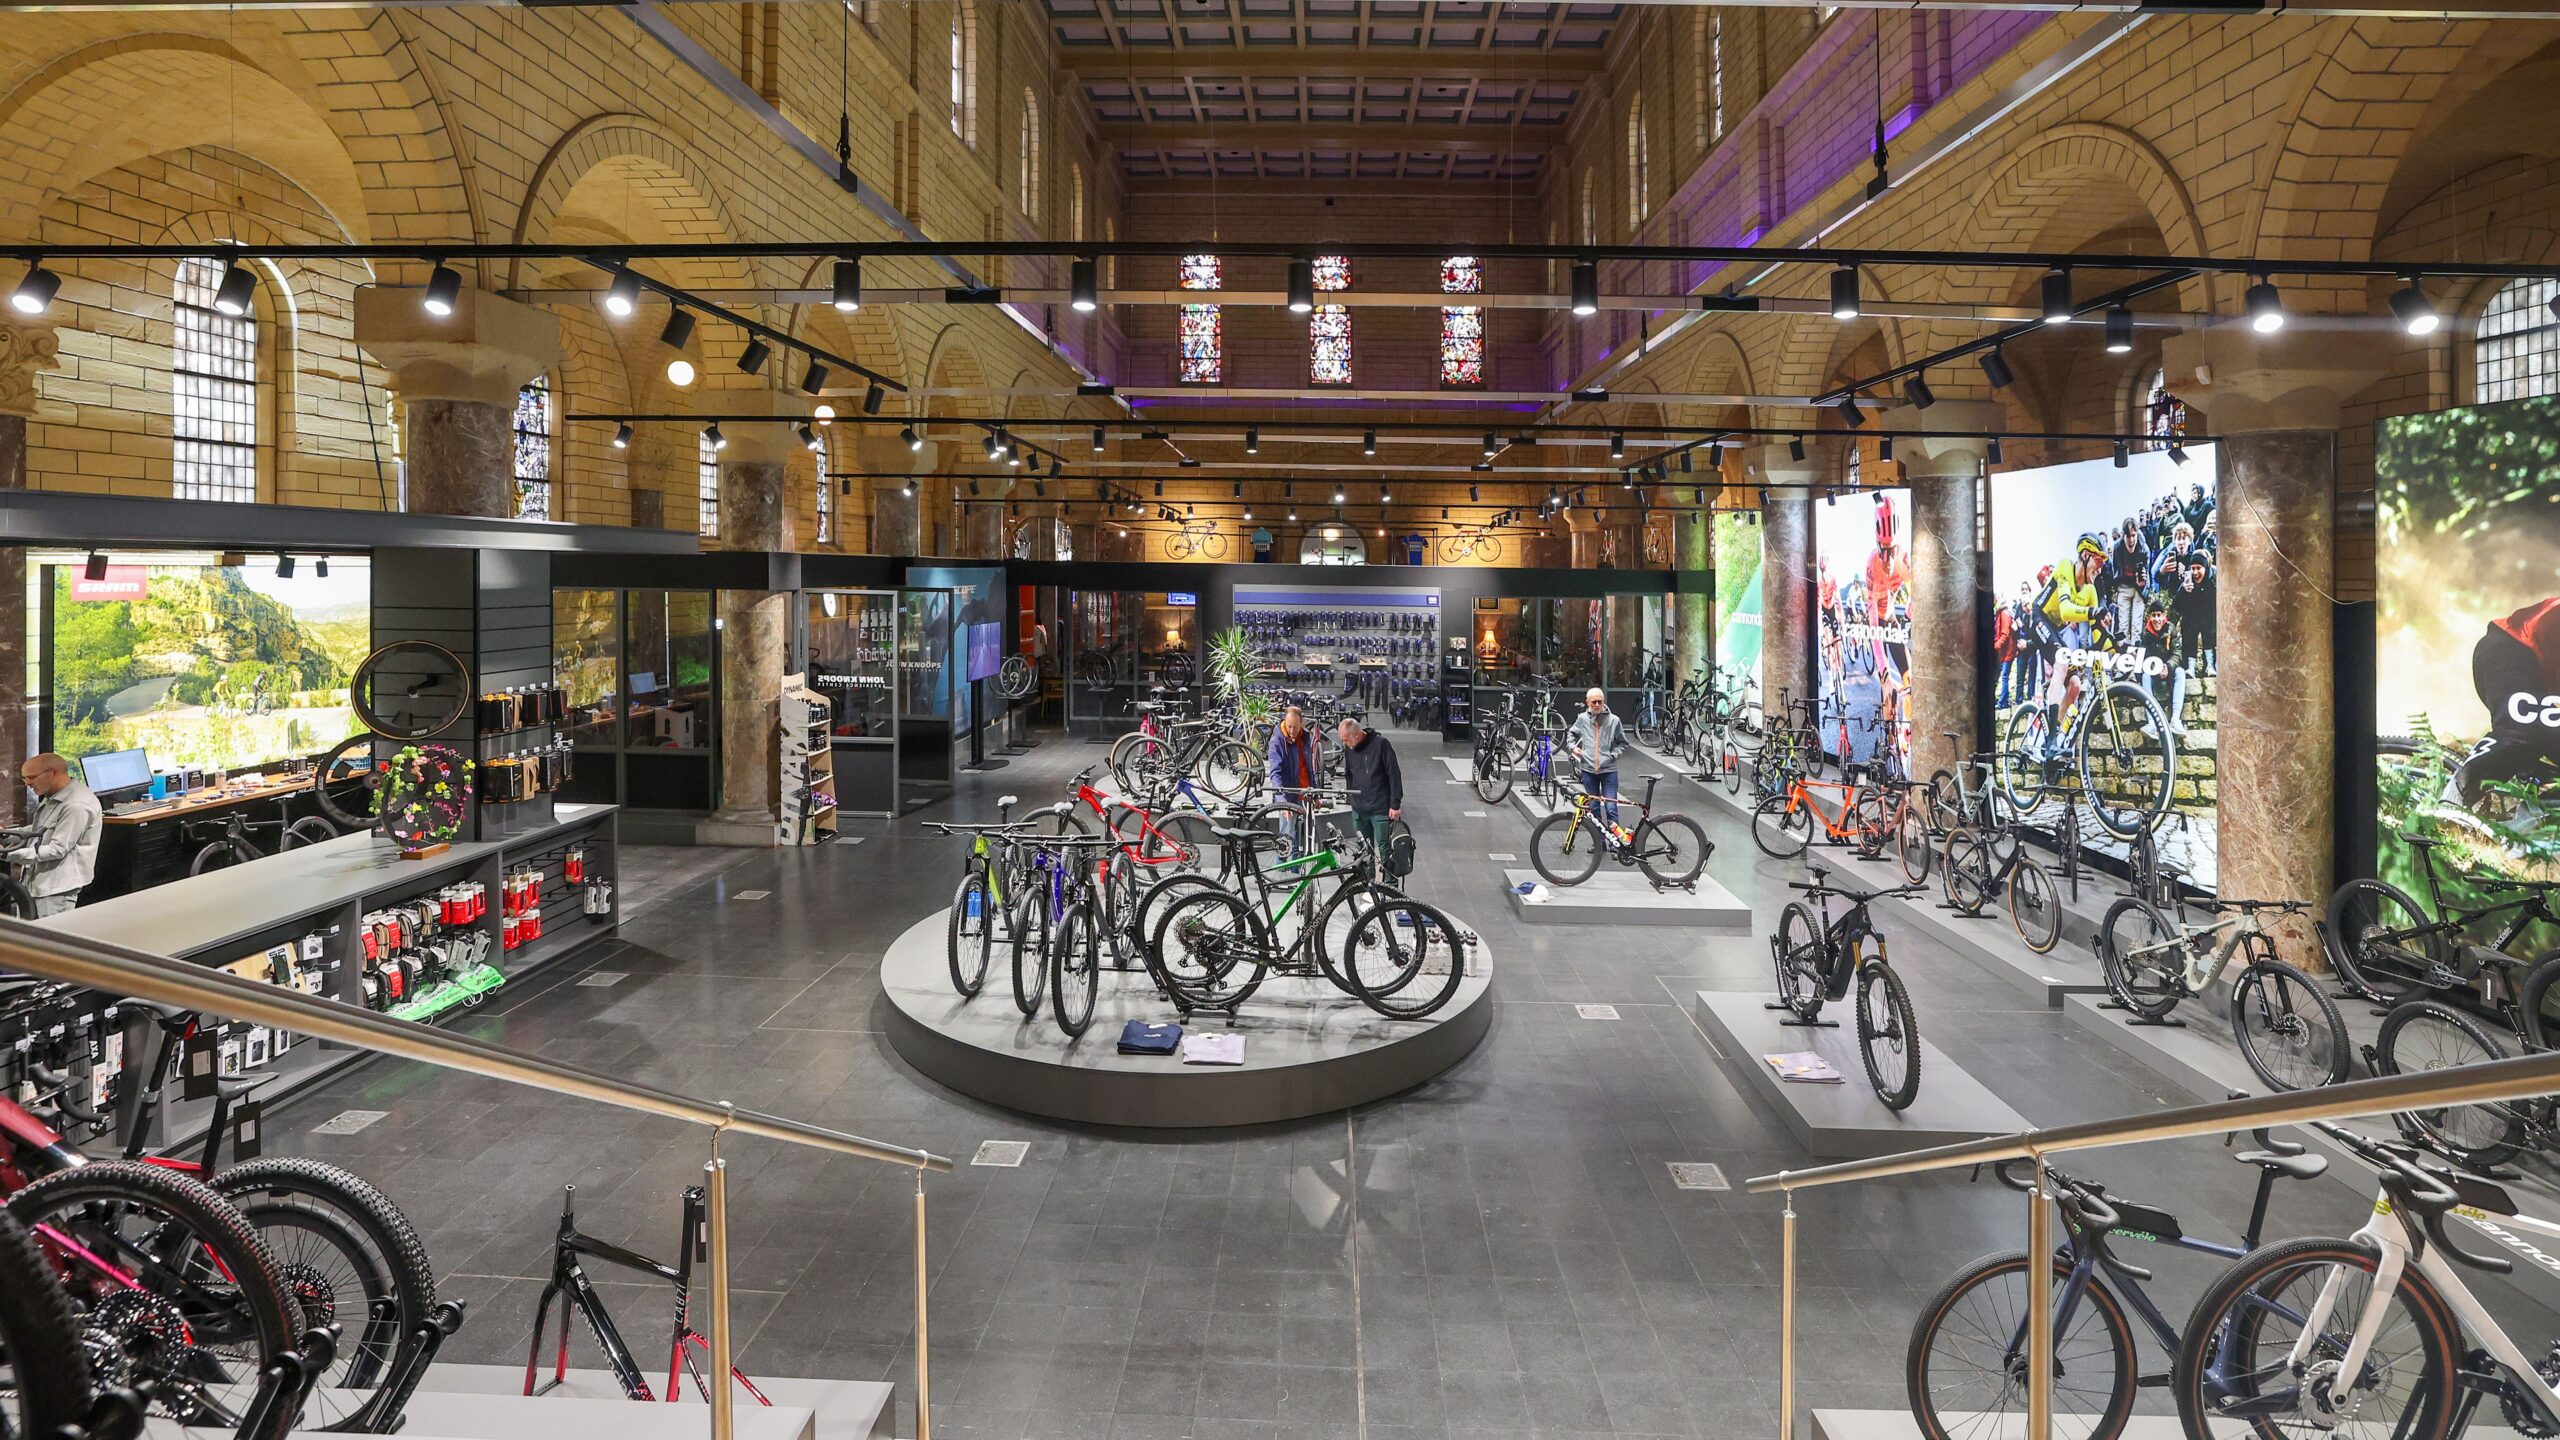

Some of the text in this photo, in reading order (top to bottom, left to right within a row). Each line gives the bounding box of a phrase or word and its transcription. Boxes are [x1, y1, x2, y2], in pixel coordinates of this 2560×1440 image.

[77, 582, 139, 592] SRAM
[1843, 622, 1909, 645] cannondale
[2055, 645, 2163, 676] cervélo
[89, 1041, 99, 1058] AXA
[673, 1283, 686, 1323] LAB71
[575, 1302, 634, 1400] cannondal
